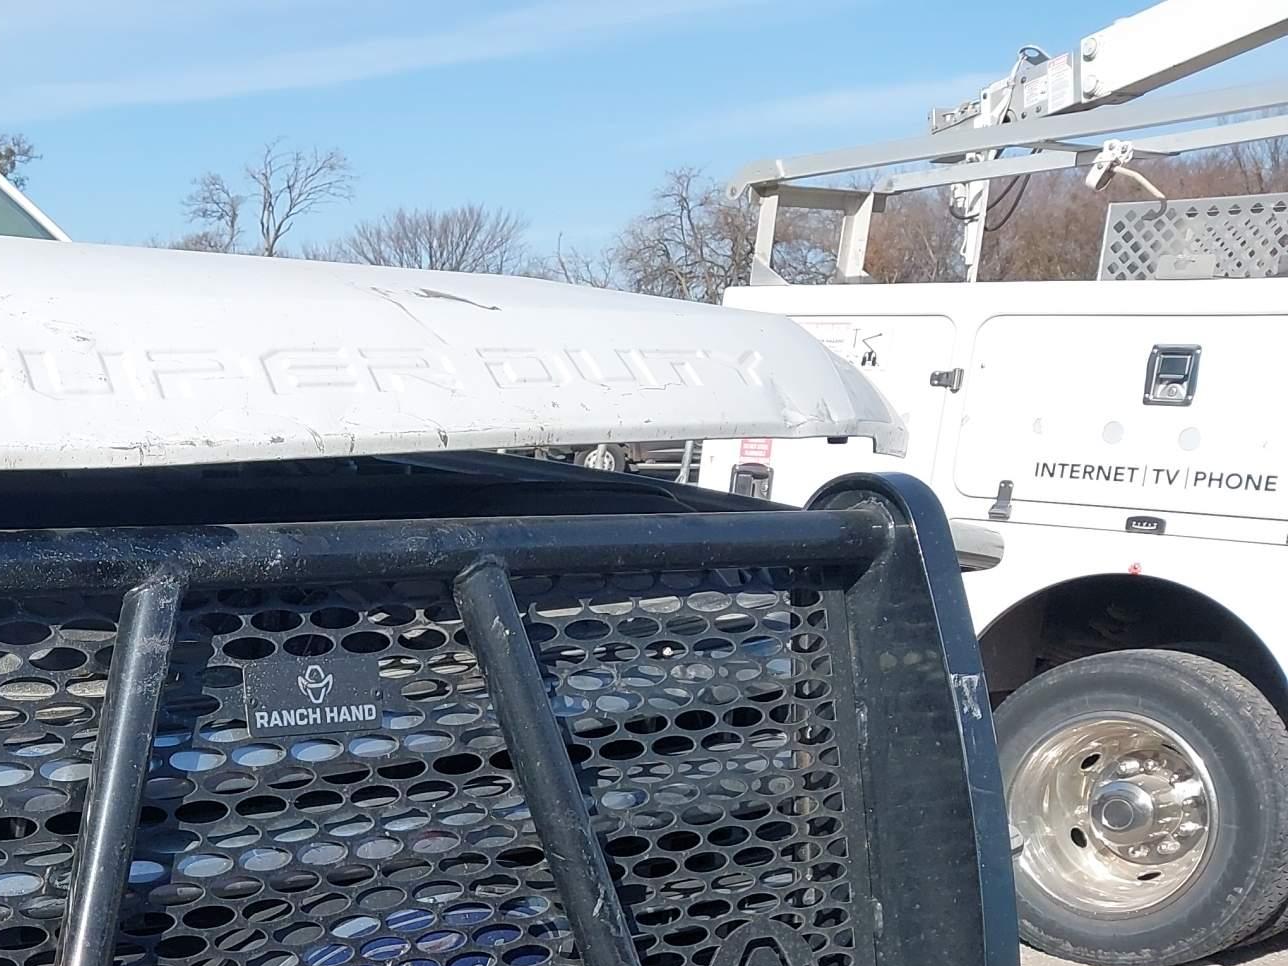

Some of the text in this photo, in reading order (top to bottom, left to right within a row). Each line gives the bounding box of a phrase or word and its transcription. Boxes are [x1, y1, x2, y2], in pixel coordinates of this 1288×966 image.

[475, 347, 763, 391] DUTY
[1034, 462, 1278, 492] INTERNET TV PHONE
[255, 704, 377, 729] RANCH HAND
